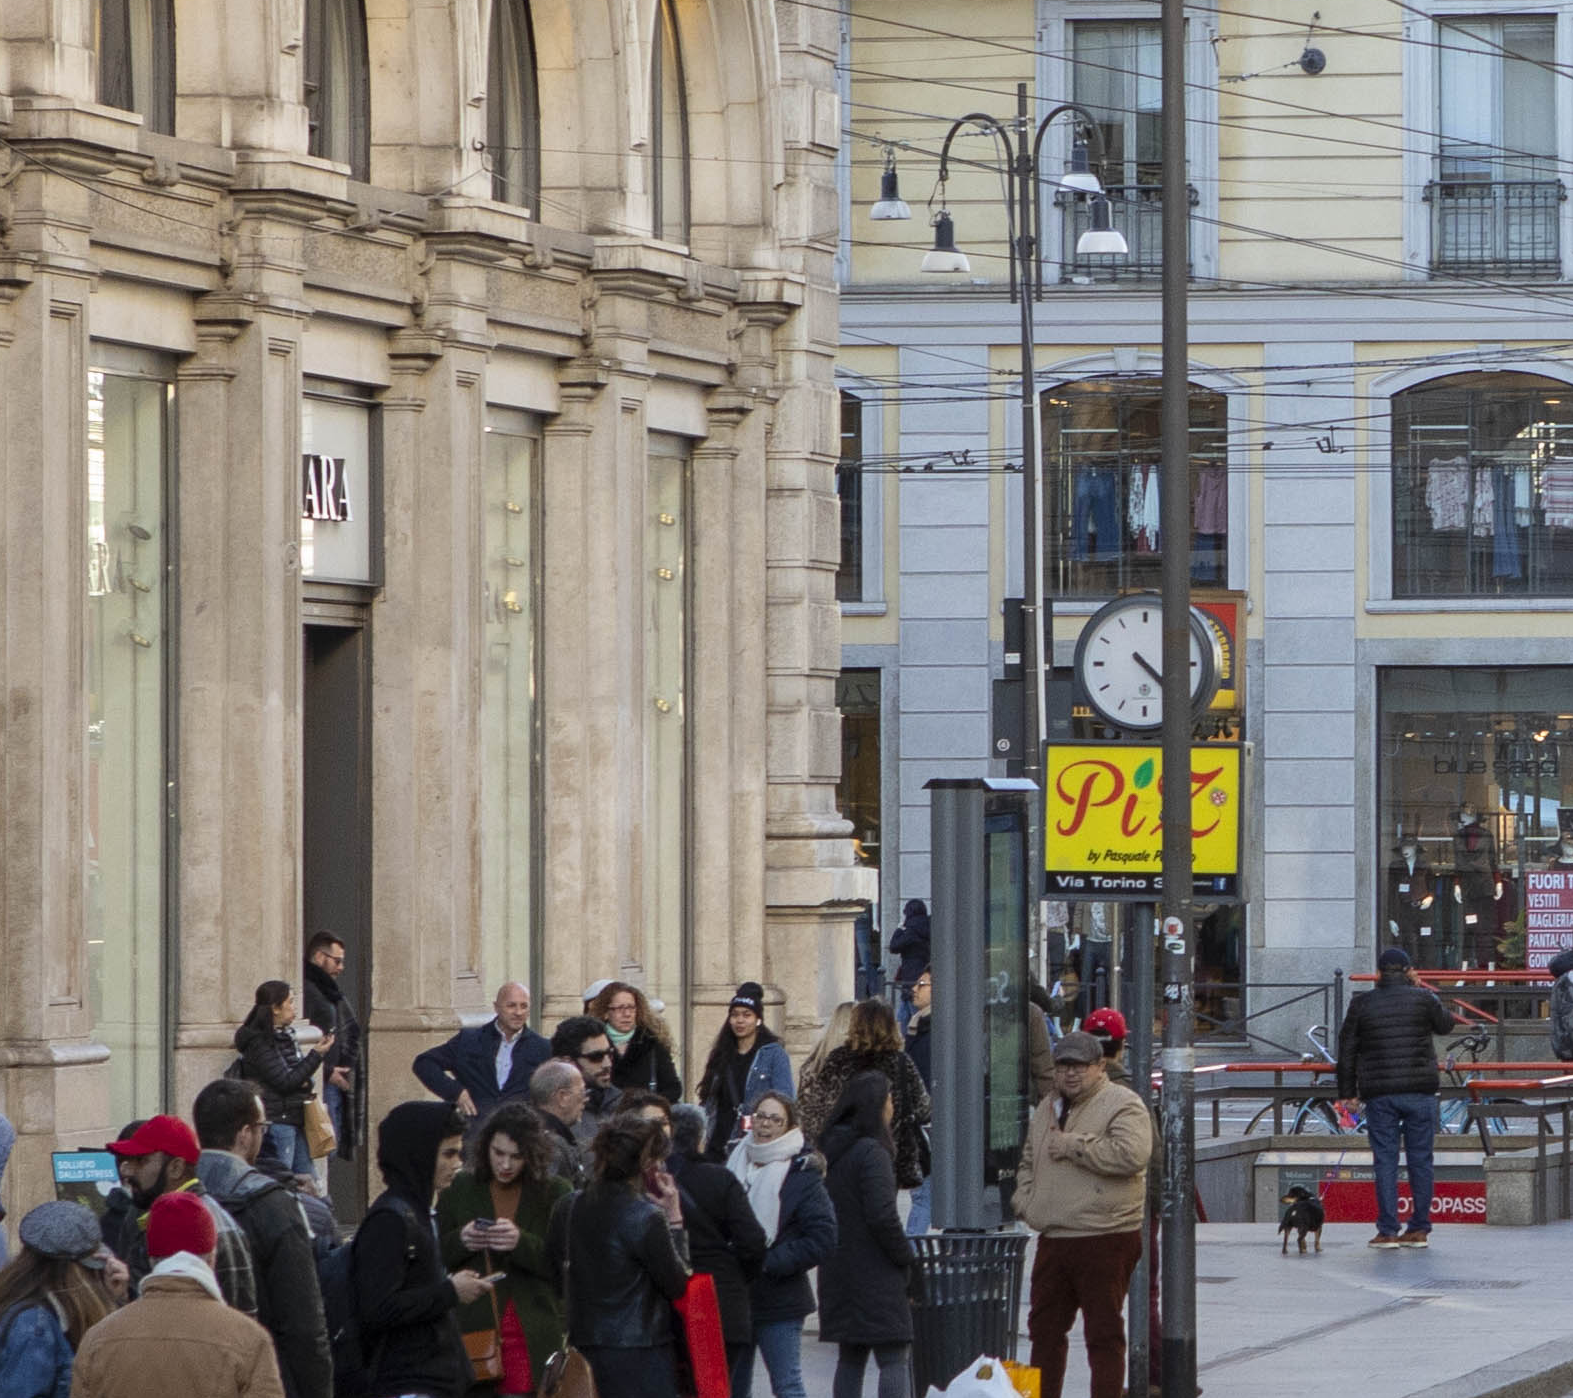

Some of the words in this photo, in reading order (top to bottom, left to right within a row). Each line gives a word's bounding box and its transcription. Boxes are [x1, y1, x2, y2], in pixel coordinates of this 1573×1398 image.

[1103, 849, 1150, 863] Pasquale
[1056, 875, 1085, 888] Via
[1090, 875, 1147, 889] Torino
[1528, 873, 1565, 890] FUORI
[1528, 894, 1560, 908] VESTITI
